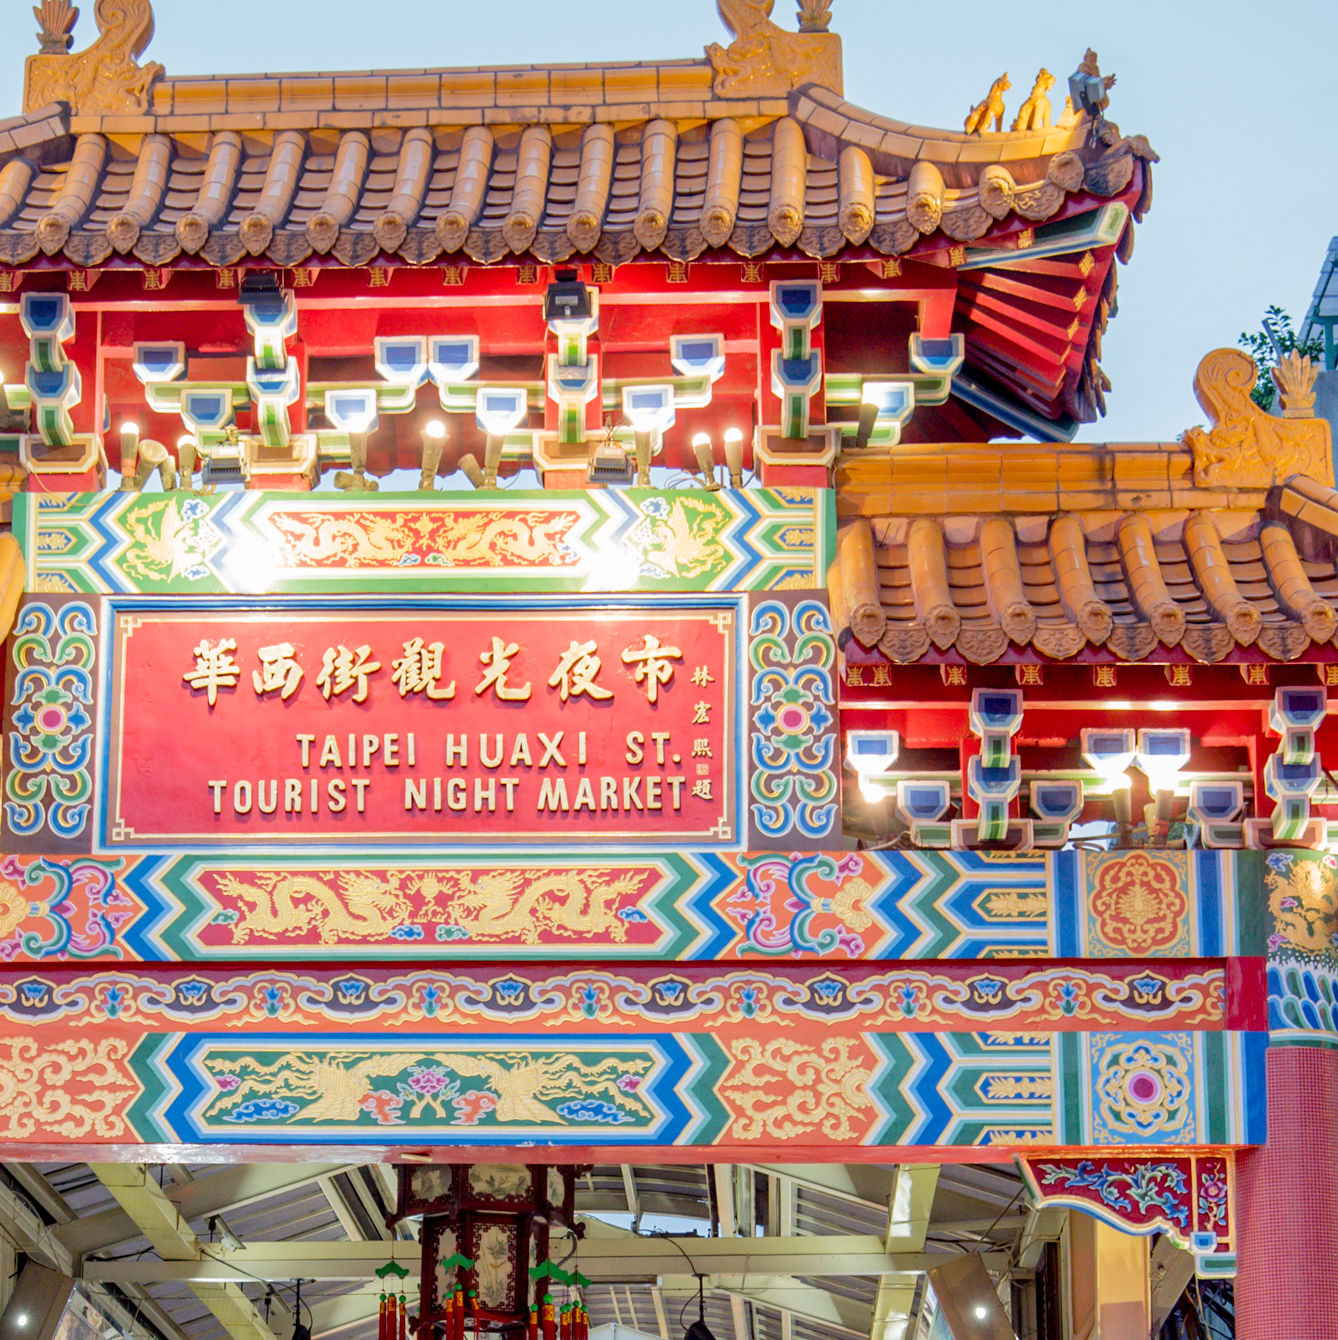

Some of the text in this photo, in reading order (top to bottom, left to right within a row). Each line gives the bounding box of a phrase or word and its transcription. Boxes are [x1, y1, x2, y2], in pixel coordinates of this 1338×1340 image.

[182, 635, 683, 706] 華西街觀光夜市
[297, 732, 682, 767] TAIPEI HUAXI ST.
[208, 776, 686, 813] TOURIST NIGHT MARKET
